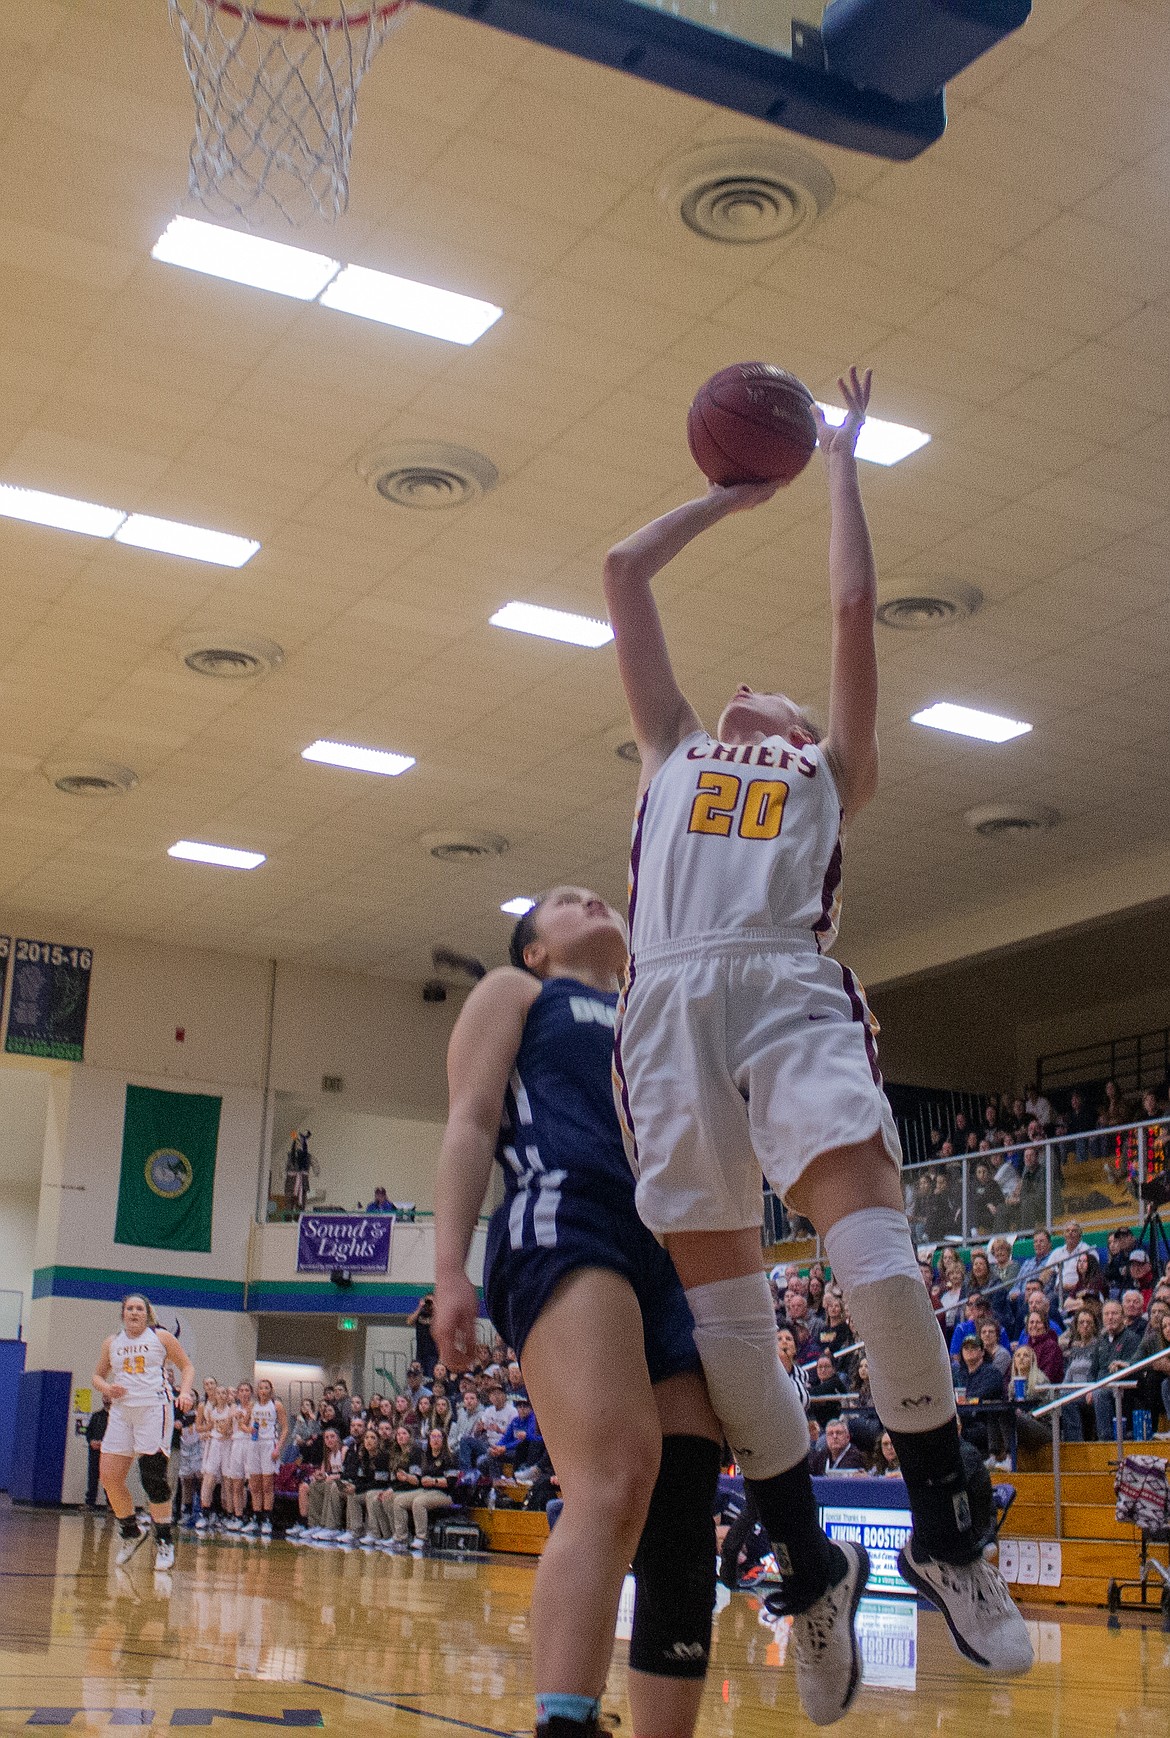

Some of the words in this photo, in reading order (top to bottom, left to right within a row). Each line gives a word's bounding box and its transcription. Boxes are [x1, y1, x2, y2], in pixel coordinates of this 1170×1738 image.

[686, 743, 817, 778] CHIEFS
[686, 771, 790, 841] 20
[16, 941, 92, 971] 2015-16
[302, 1219, 368, 1239] Sound
[370, 1222, 387, 1239] &
[318, 1237, 376, 1263] Lights
[831, 1525, 862, 1544] VIKING
